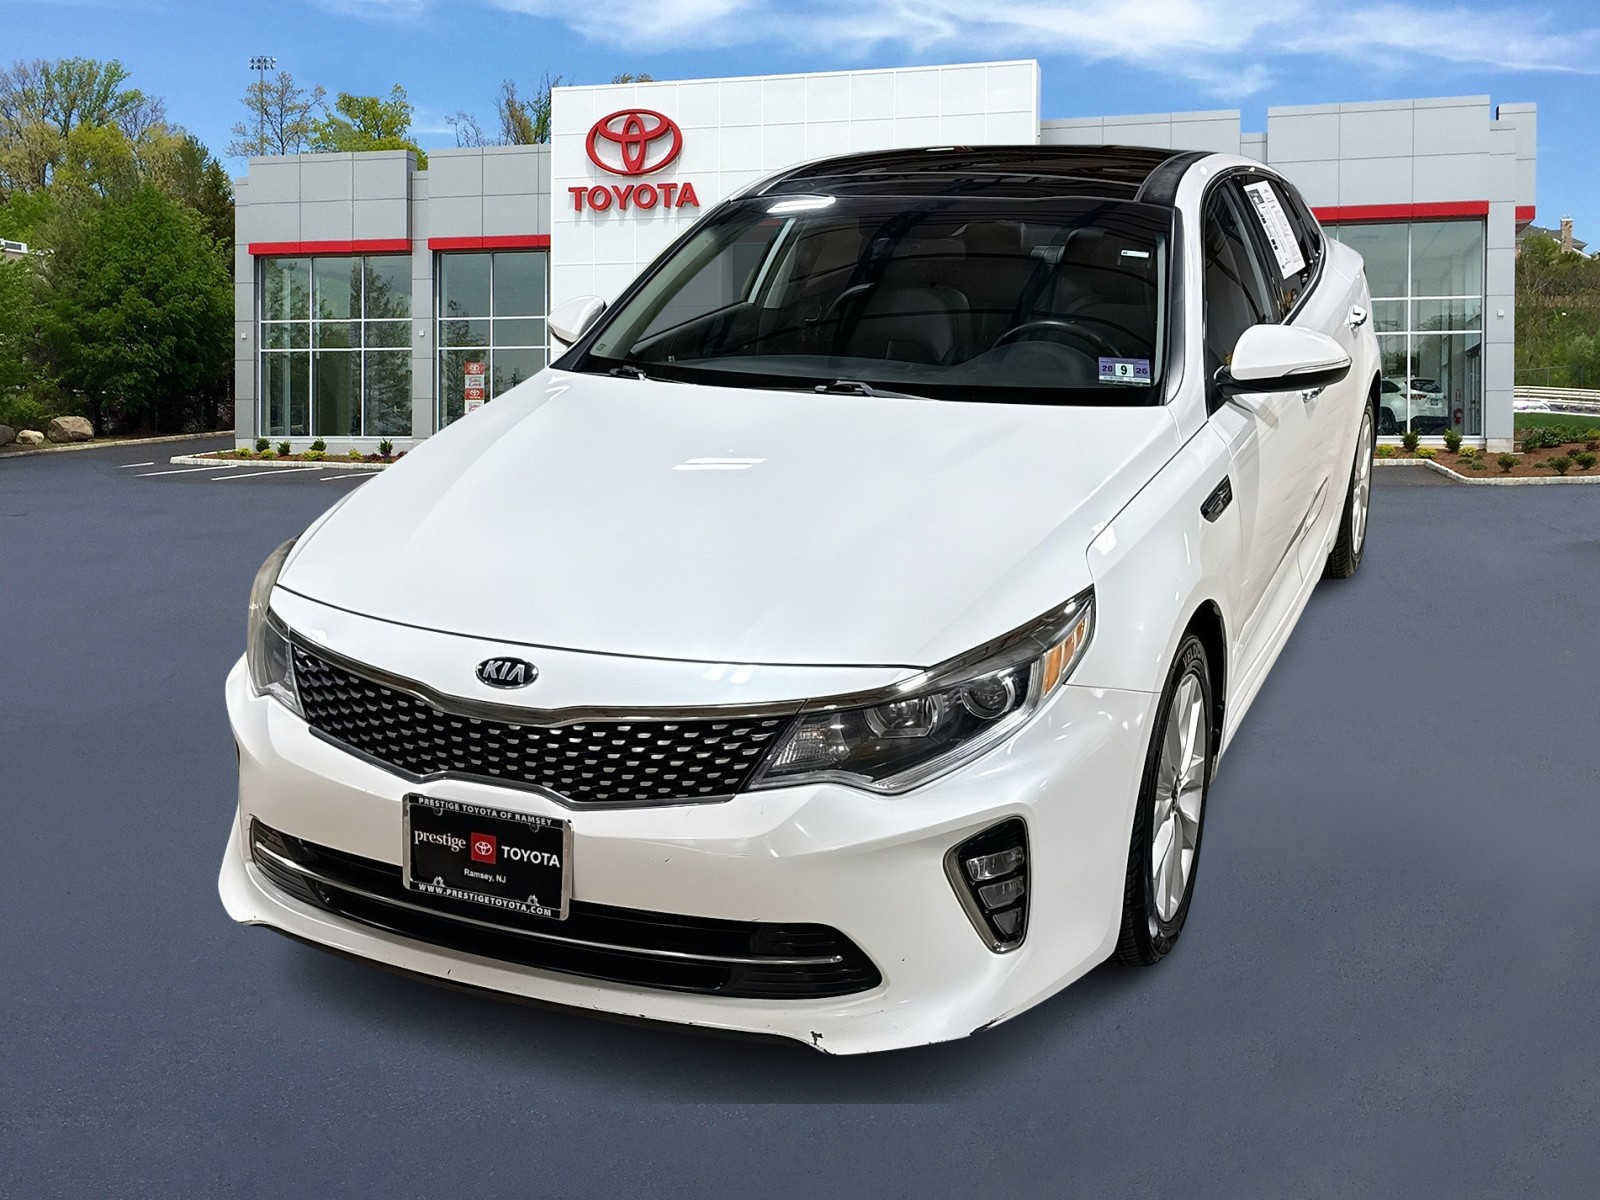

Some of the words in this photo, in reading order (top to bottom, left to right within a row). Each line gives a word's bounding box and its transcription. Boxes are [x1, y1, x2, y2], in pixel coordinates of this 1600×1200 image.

[568, 182, 700, 212] TOYOTA
[1120, 364, 1128, 376] 9
[482, 660, 526, 683] KIA
[418, 797, 460, 811] PRESTIGE
[462, 804, 498, 818] TOYOTA
[500, 811, 512, 819] OF
[514, 814, 553, 827] RAMSEY
[414, 830, 467, 853] prestige
[501, 845, 561, 868] TOYOTA
[463, 868, 495, 882] Ramsey,
[495, 875, 507, 884] NJ
[418, 882, 552, 917] WWW.PRESTIGETOYOTA.COM
